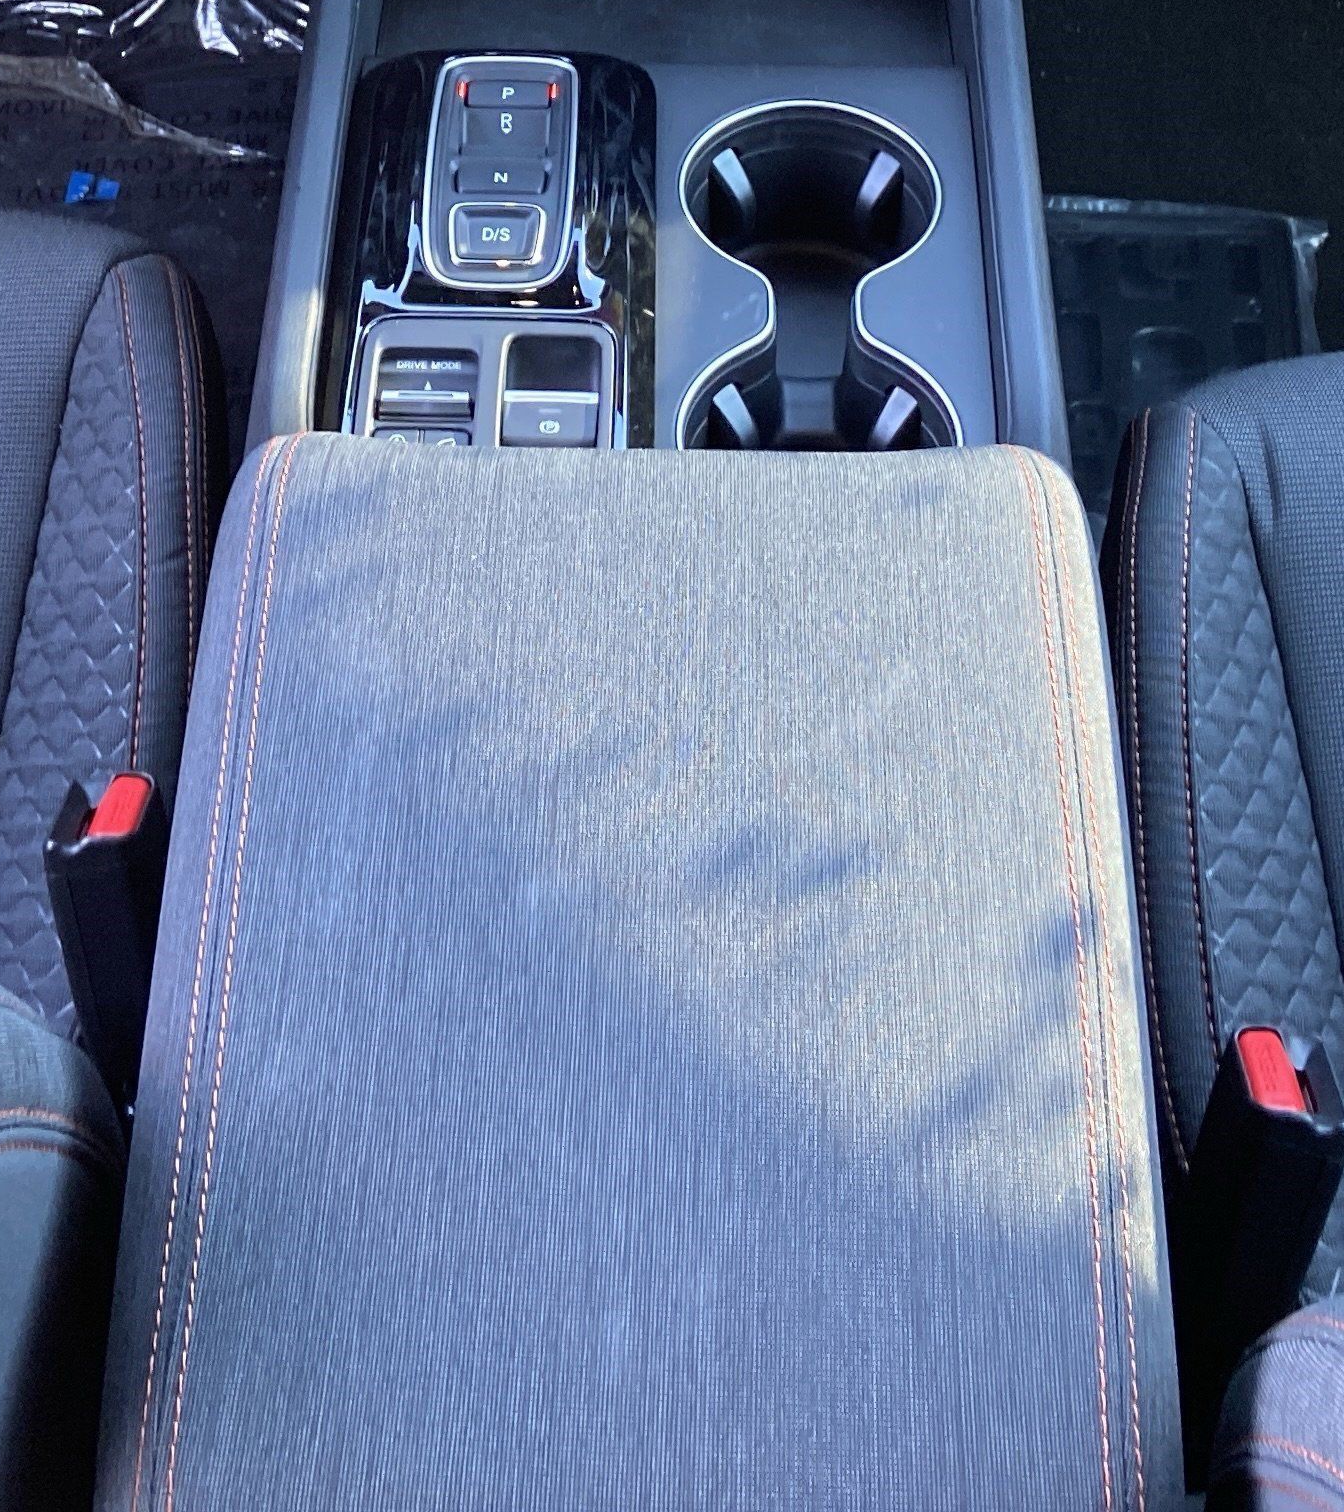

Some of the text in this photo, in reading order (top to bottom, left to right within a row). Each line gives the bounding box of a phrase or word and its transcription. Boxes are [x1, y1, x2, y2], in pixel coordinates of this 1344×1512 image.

[501, 87, 515, 100] P
[500, 113, 512, 128] R
[493, 172, 508, 183] N
[481, 227, 511, 244] D/S
[396, 359, 462, 370] DRIVE MODE
